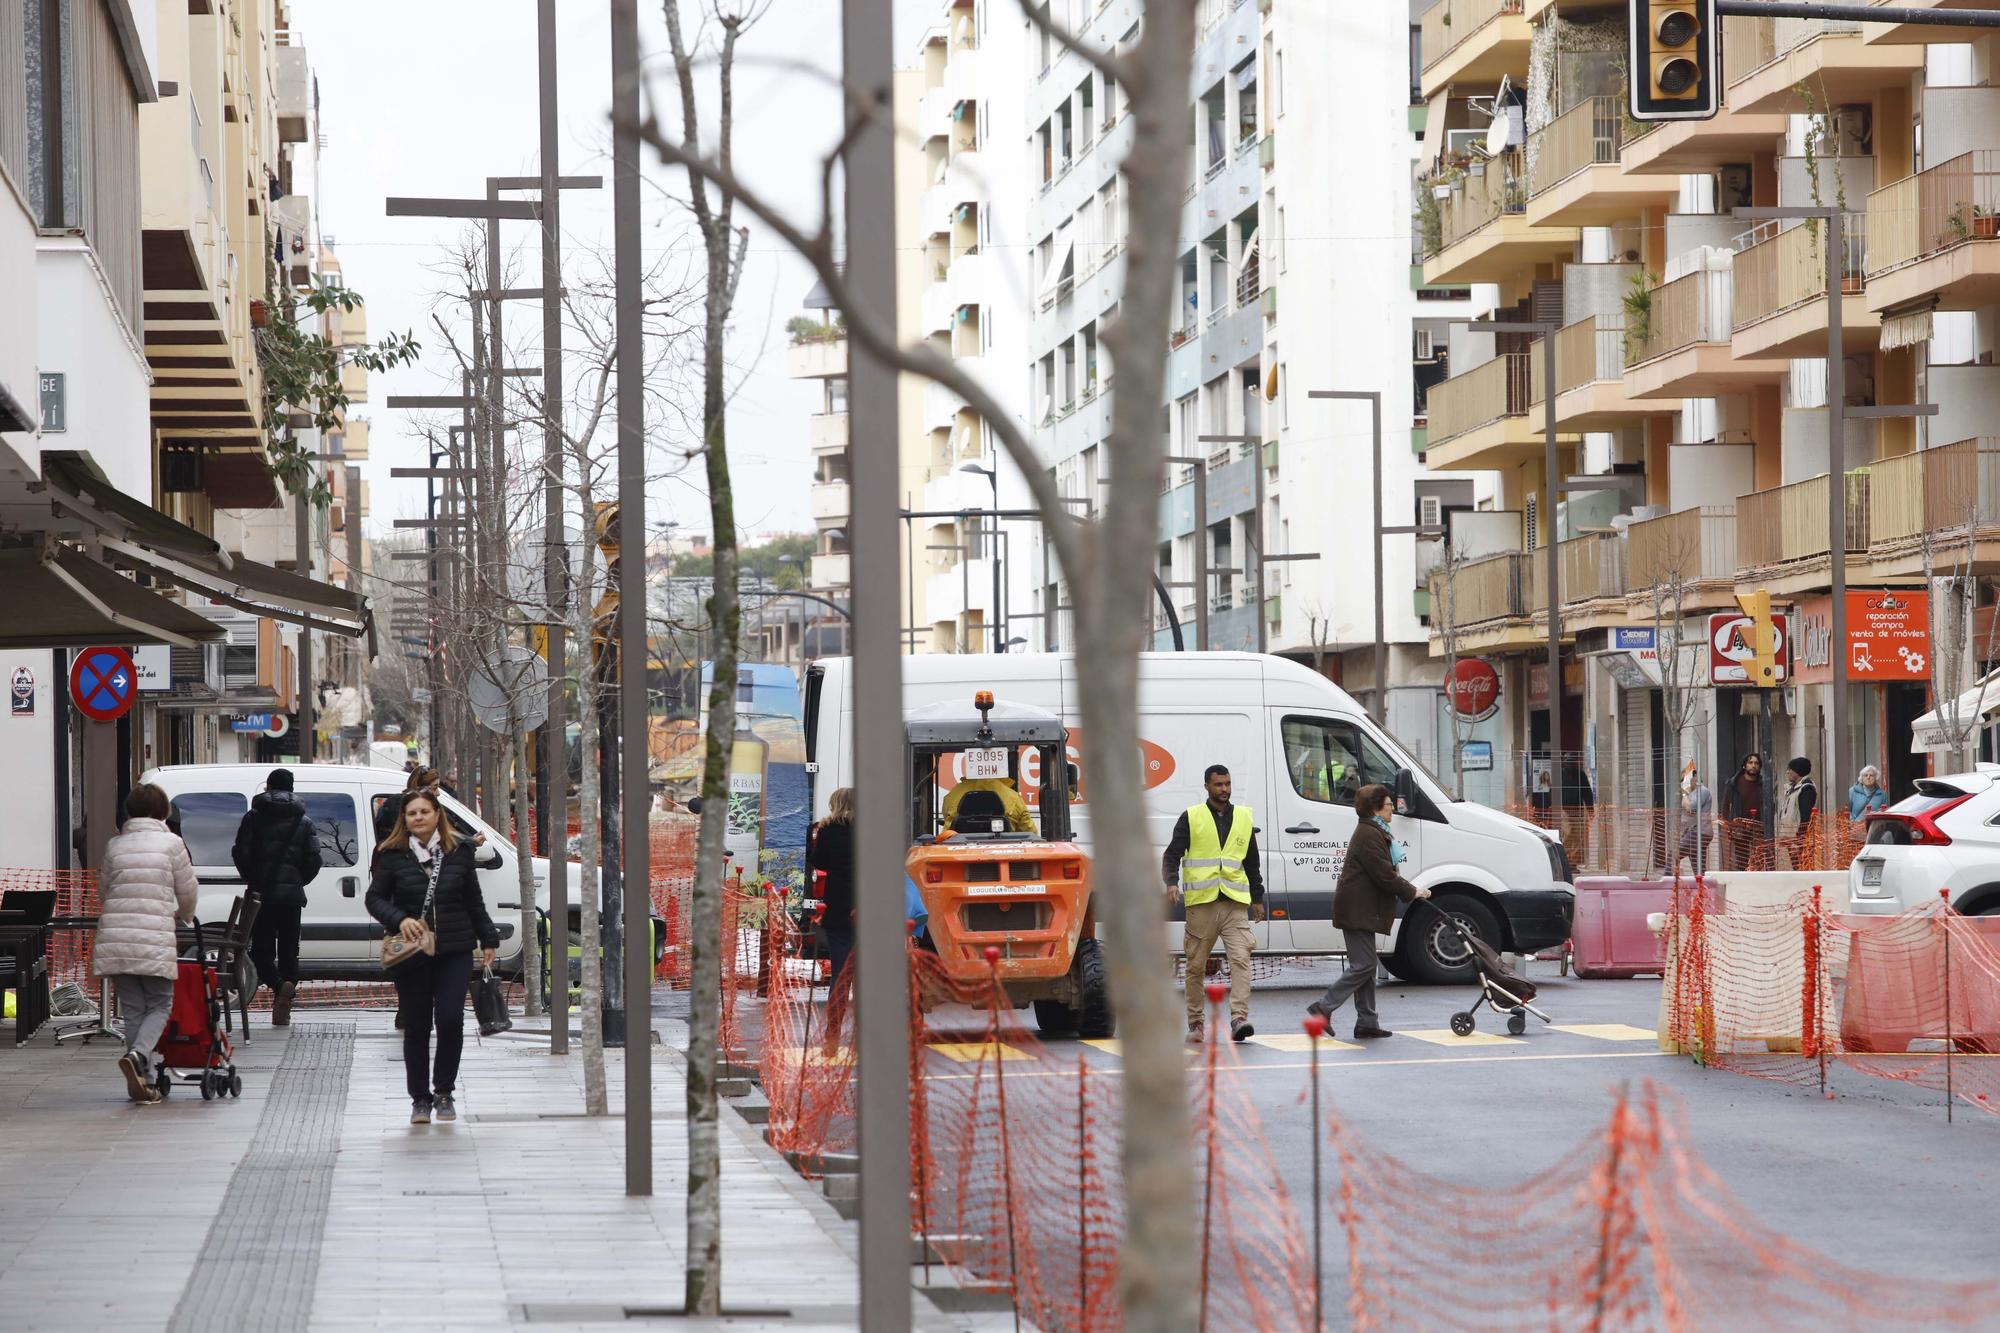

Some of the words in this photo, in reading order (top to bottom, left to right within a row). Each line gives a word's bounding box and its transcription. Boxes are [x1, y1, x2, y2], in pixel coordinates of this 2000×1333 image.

[1866, 612, 1909, 621] reparación
[1871, 622, 1904, 630] compra
[1850, 630, 1874, 638] venta
[1878, 630, 1888, 638] de
[1893, 630, 1925, 638] móviles
[977, 765, 999, 776] BHM
[1294, 841, 1341, 849] COMERCIAL
